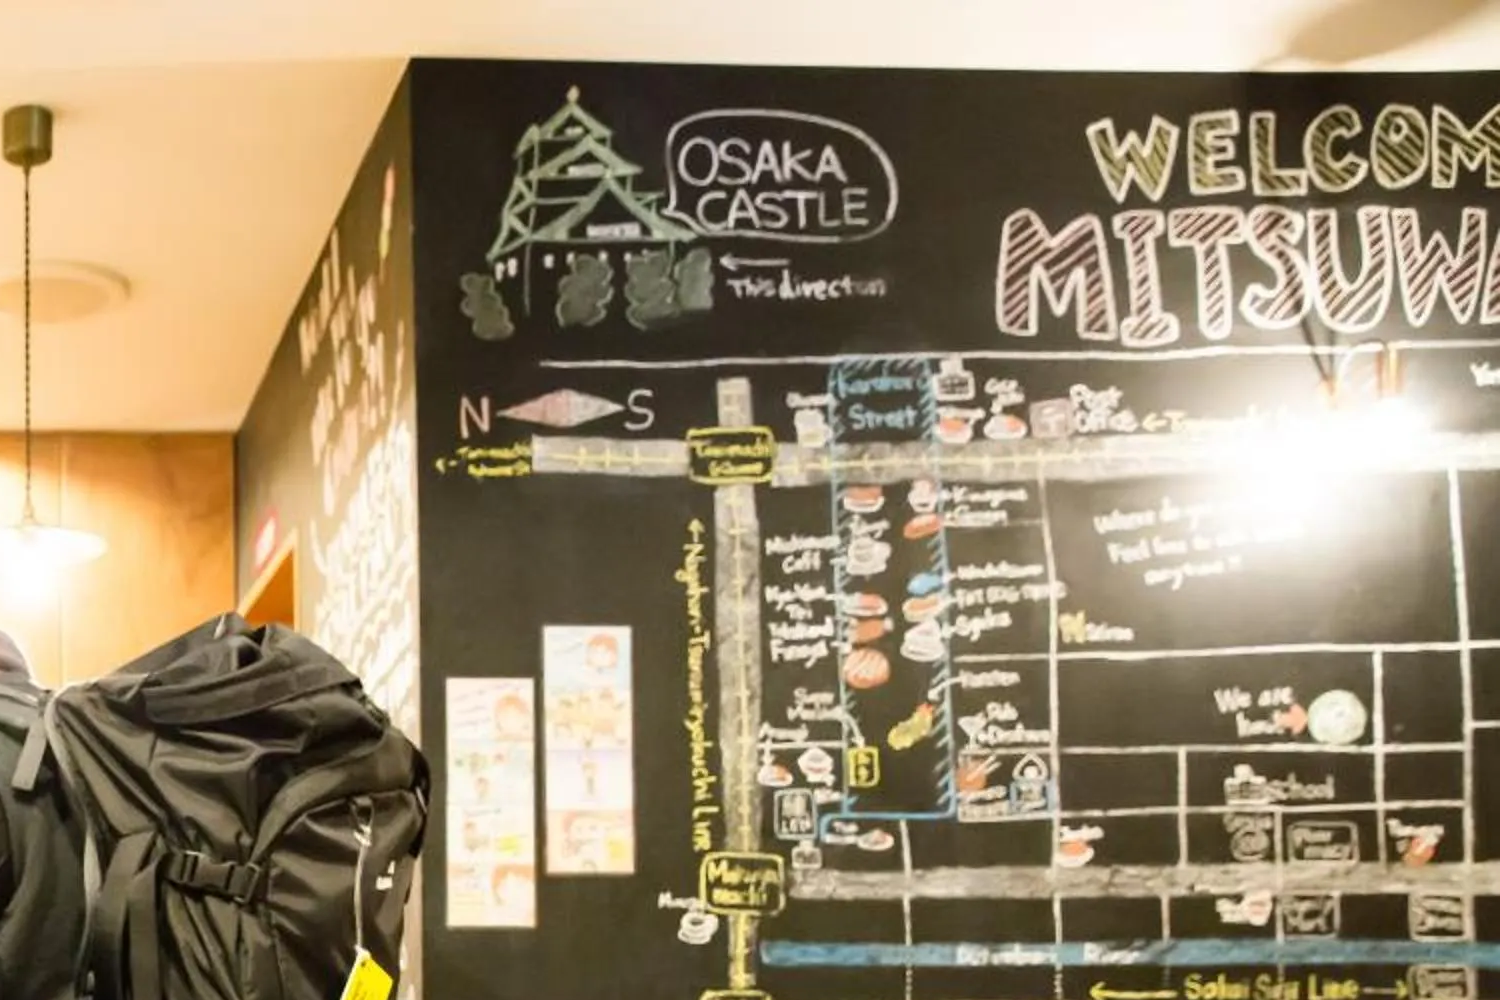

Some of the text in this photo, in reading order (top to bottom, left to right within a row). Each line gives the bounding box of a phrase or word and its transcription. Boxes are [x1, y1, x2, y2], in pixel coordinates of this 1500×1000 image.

[677, 137, 847, 186] OSAKA
[697, 187, 869, 231] CASTLE
[995, 206, 1500, 348] MITSUW
[459, 396, 491, 439] N
[624, 388, 655, 431] S
